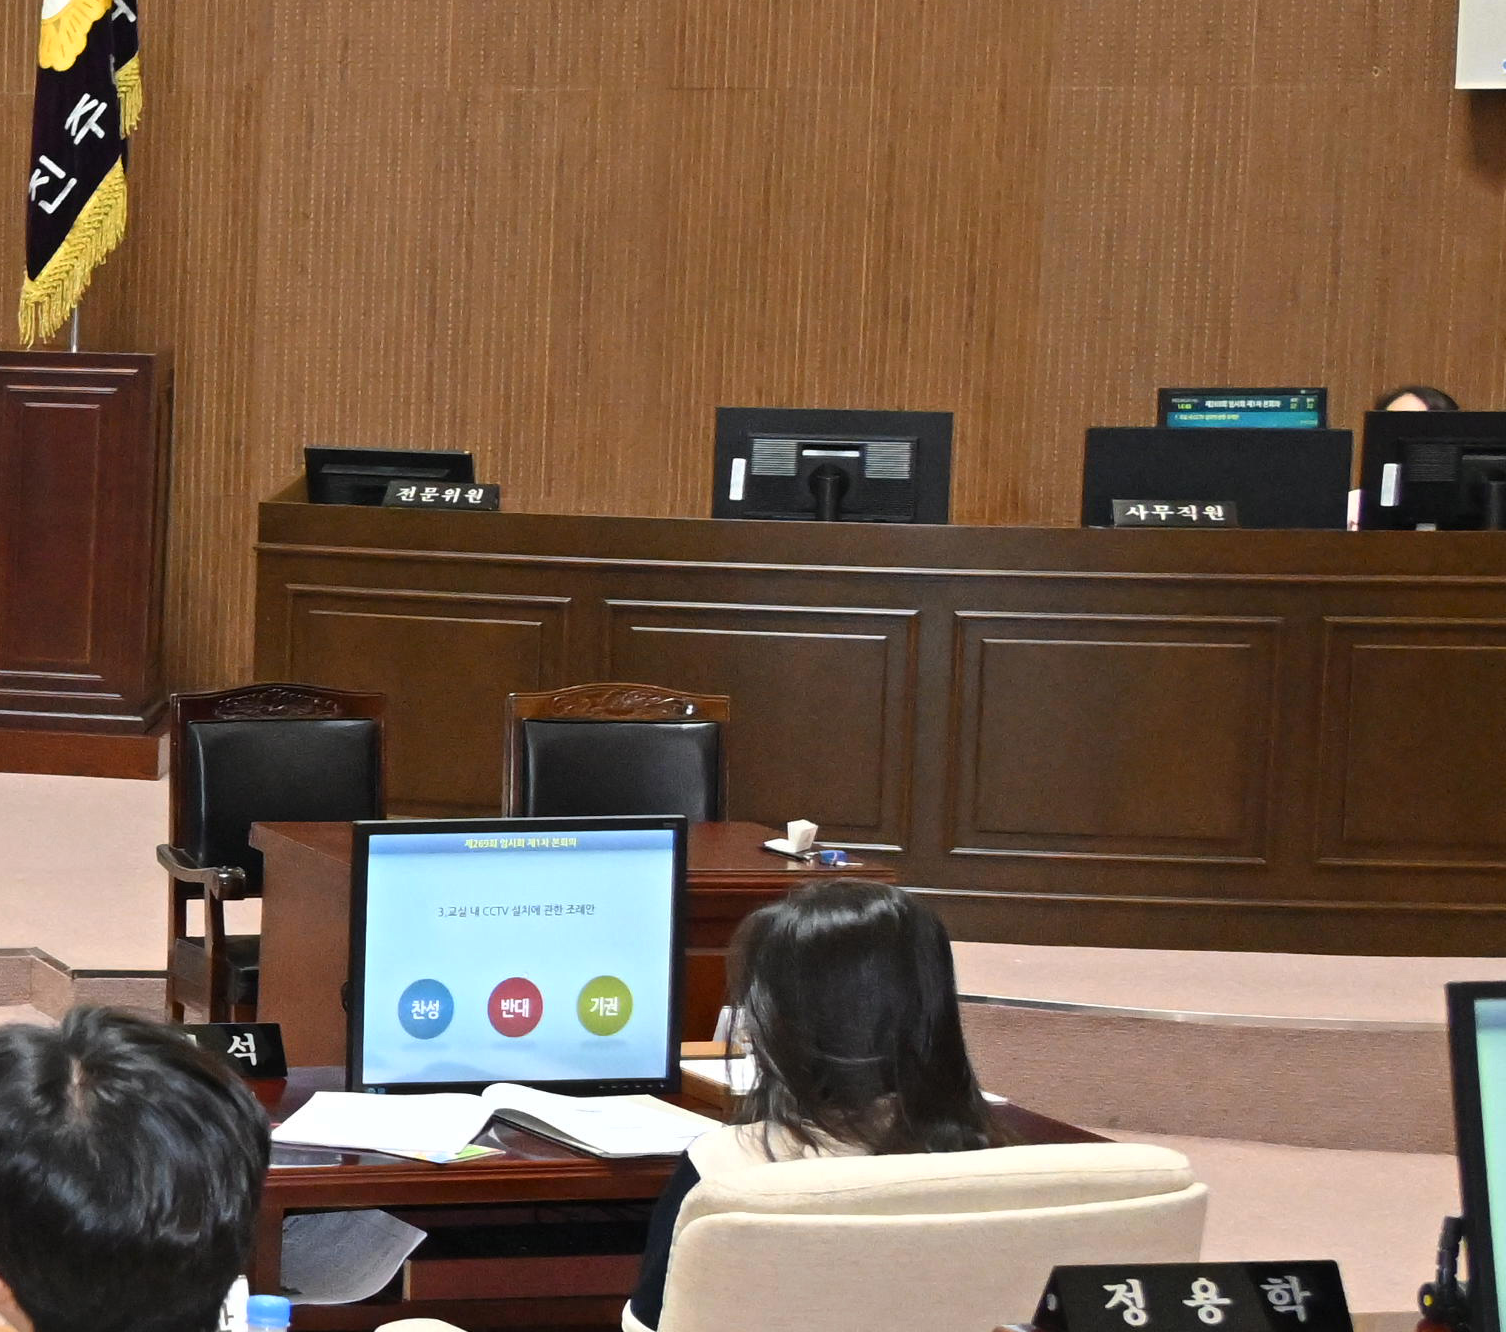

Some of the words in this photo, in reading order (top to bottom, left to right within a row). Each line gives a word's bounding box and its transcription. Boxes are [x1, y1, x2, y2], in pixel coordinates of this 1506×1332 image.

[394, 485, 486, 505] 전문위원
[1123, 501, 1227, 524] 사무직원
[482, 906, 509, 916] CCTV
[410, 998, 441, 1020] 찬성
[500, 996, 531, 1019] 반대
[589, 994, 620, 1017] 기권
